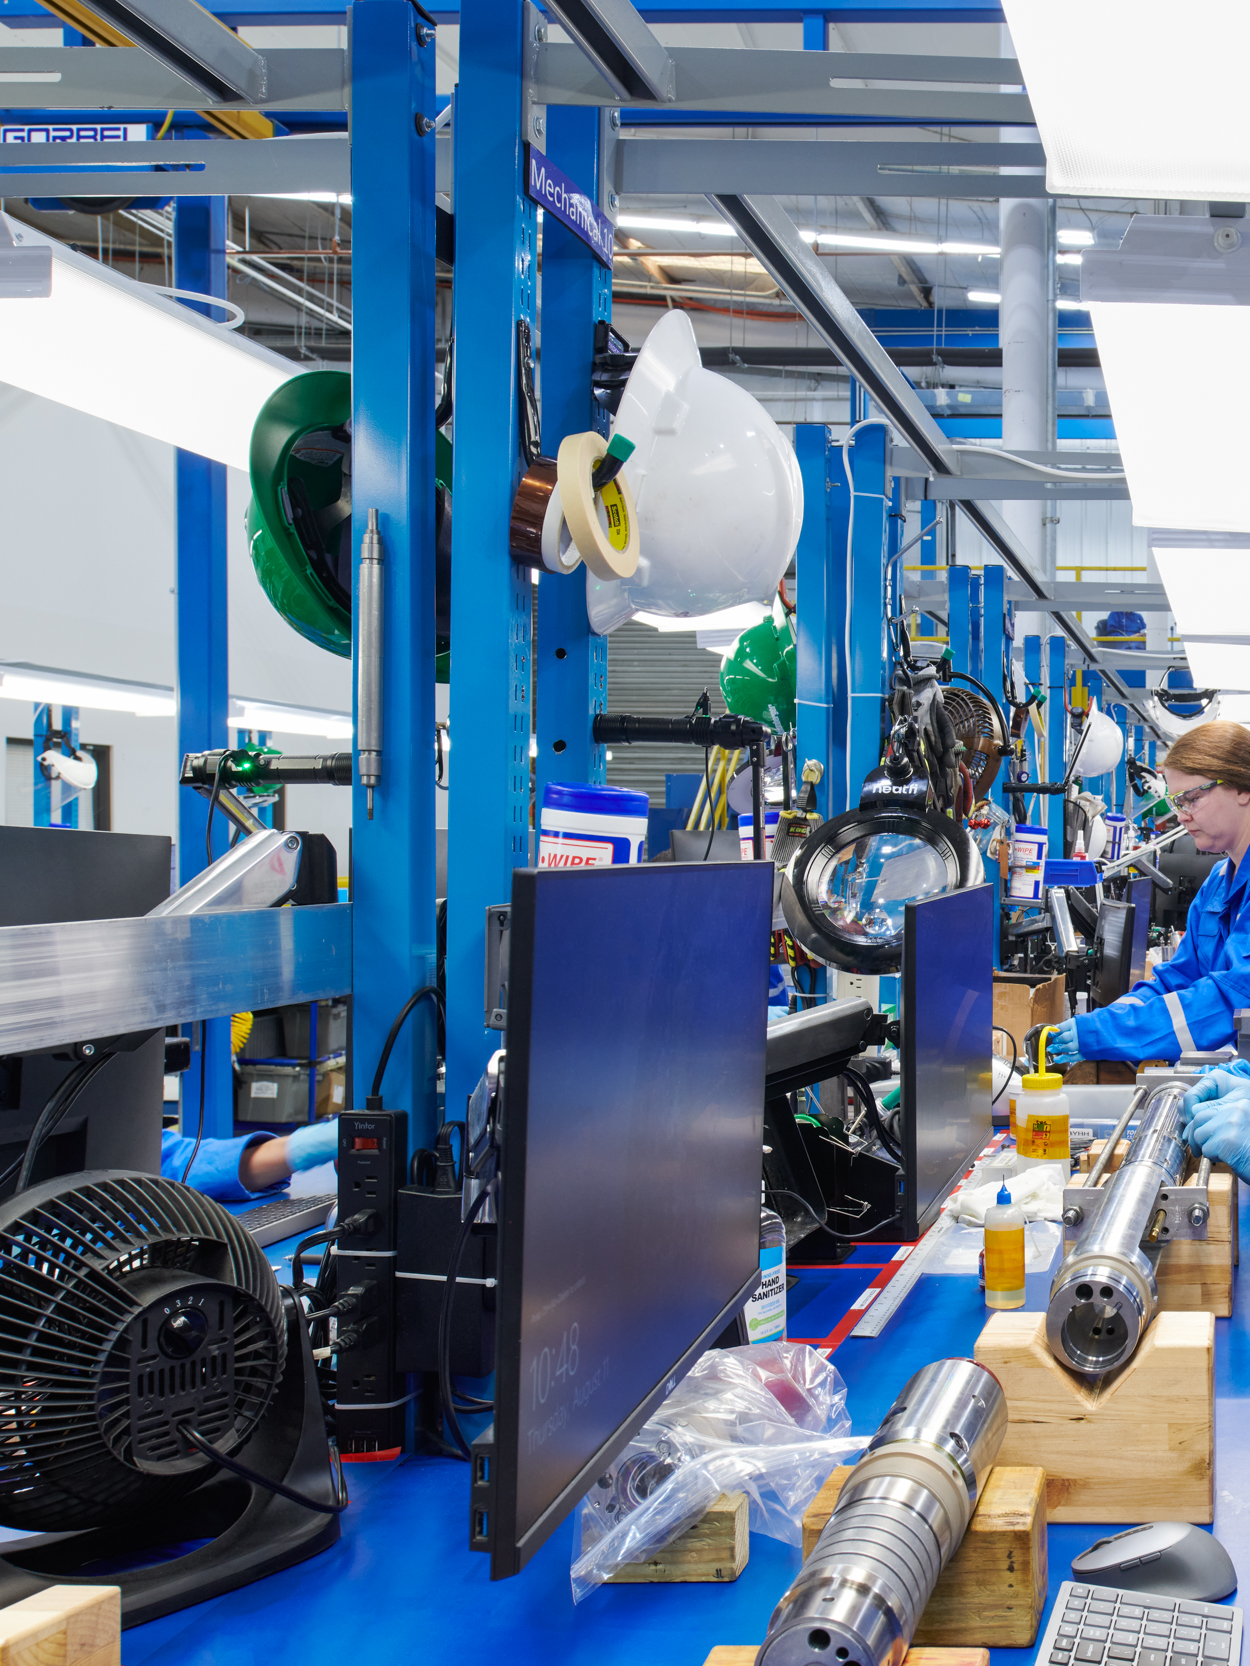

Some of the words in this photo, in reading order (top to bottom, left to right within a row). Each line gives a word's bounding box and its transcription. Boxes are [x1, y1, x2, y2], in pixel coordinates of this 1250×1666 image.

[531, 159, 603, 247] Mechanical
[873, 783, 918, 795] neatfi
[761, 1276, 780, 1289] HAND
[751, 1283, 784, 1302] SANITIZER
[176, 1299, 181, 1307] 3
[188, 1296, 193, 1304] 2
[529, 1322, 579, 1411] 10:48
